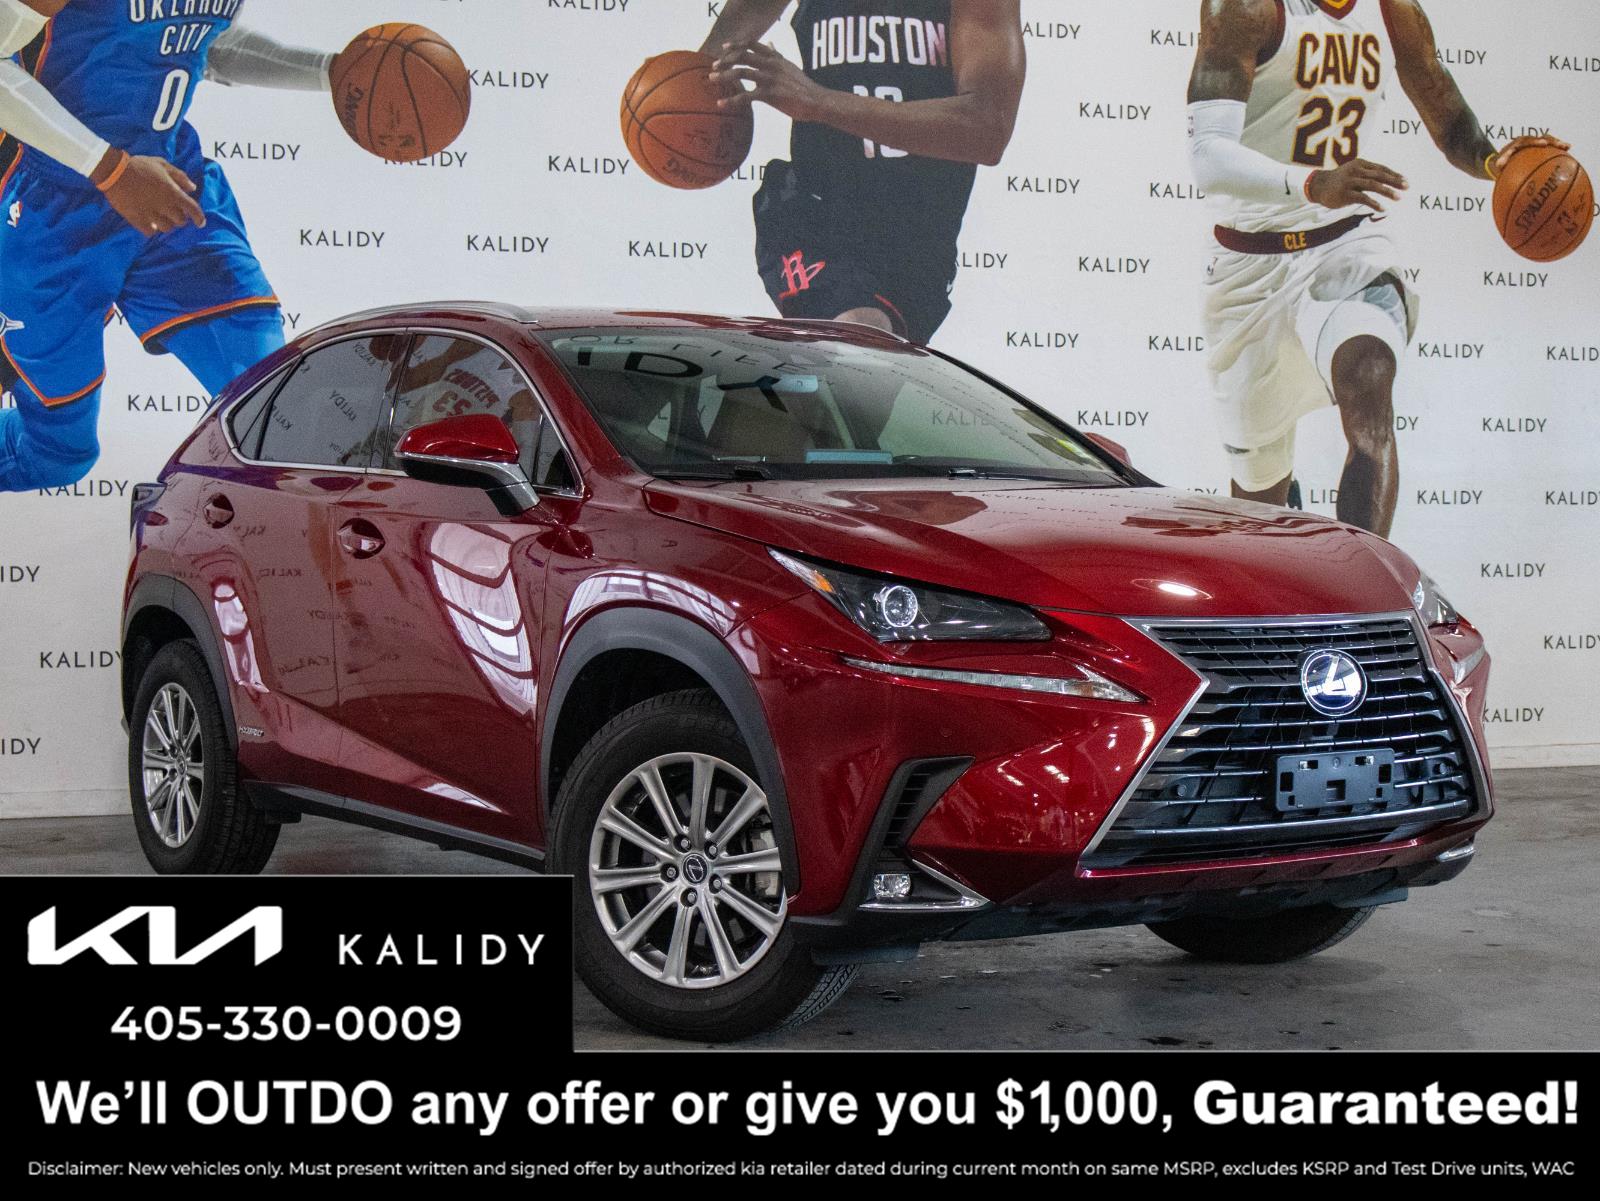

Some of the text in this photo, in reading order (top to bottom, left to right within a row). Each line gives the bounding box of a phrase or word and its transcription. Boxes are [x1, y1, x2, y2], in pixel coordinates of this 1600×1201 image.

[130, 0, 240, 22] OKLAHOM
[160, 23, 213, 55] CITY
[1022, 22, 1081, 40] ALIDY
[1151, 29, 1202, 47] KALI
[811, 15, 948, 70] HOUSTON
[1295, 31, 1382, 91] CAVS
[1435, 48, 1487, 65] ALIDY
[1549, 55, 1600, 73] KALID
[468, 69, 549, 89] KALIDY
[151, 68, 190, 132] 0
[1079, 102, 1151, 120] KALIDY
[1291, 95, 1367, 169] 23
[1383, 119, 1422, 135] IDY
[213, 140, 301, 162] KALIDY
[548, 155, 630, 175] KALIDY
[1007, 175, 1081, 194] KALIDY
[1419, 194, 1486, 213] KALIDY
[300, 228, 385, 249] KALIDY
[466, 234, 549, 254] KALIDY
[1283, 232, 1308, 250] CLE
[628, 240, 708, 260] KALIDY
[955, 252, 1008, 269] LIDY
[1078, 256, 1151, 274] KALIDY
[1483, 271, 1549, 288] KALIDY
[1006, 331, 1080, 349] KALIDY
[1149, 335, 1204, 352] KALID
[1418, 342, 1485, 359] KALIDY
[1547, 346, 1600, 361] KALID
[1078, 410, 1150, 427] KALIDY
[1482, 417, 1548, 433] KALIDY
[1416, 489, 1483, 505] KALIDY
[1546, 490, 1600, 506] KALID
[0, 565, 41, 583] IDY
[1481, 562, 1546, 578] KALIDY
[1544, 634, 1600, 650] KALID
[39, 650, 121, 669] KALID
[1482, 707, 1545, 723] KALIDY
[1, 737, 42, 756] IDY
